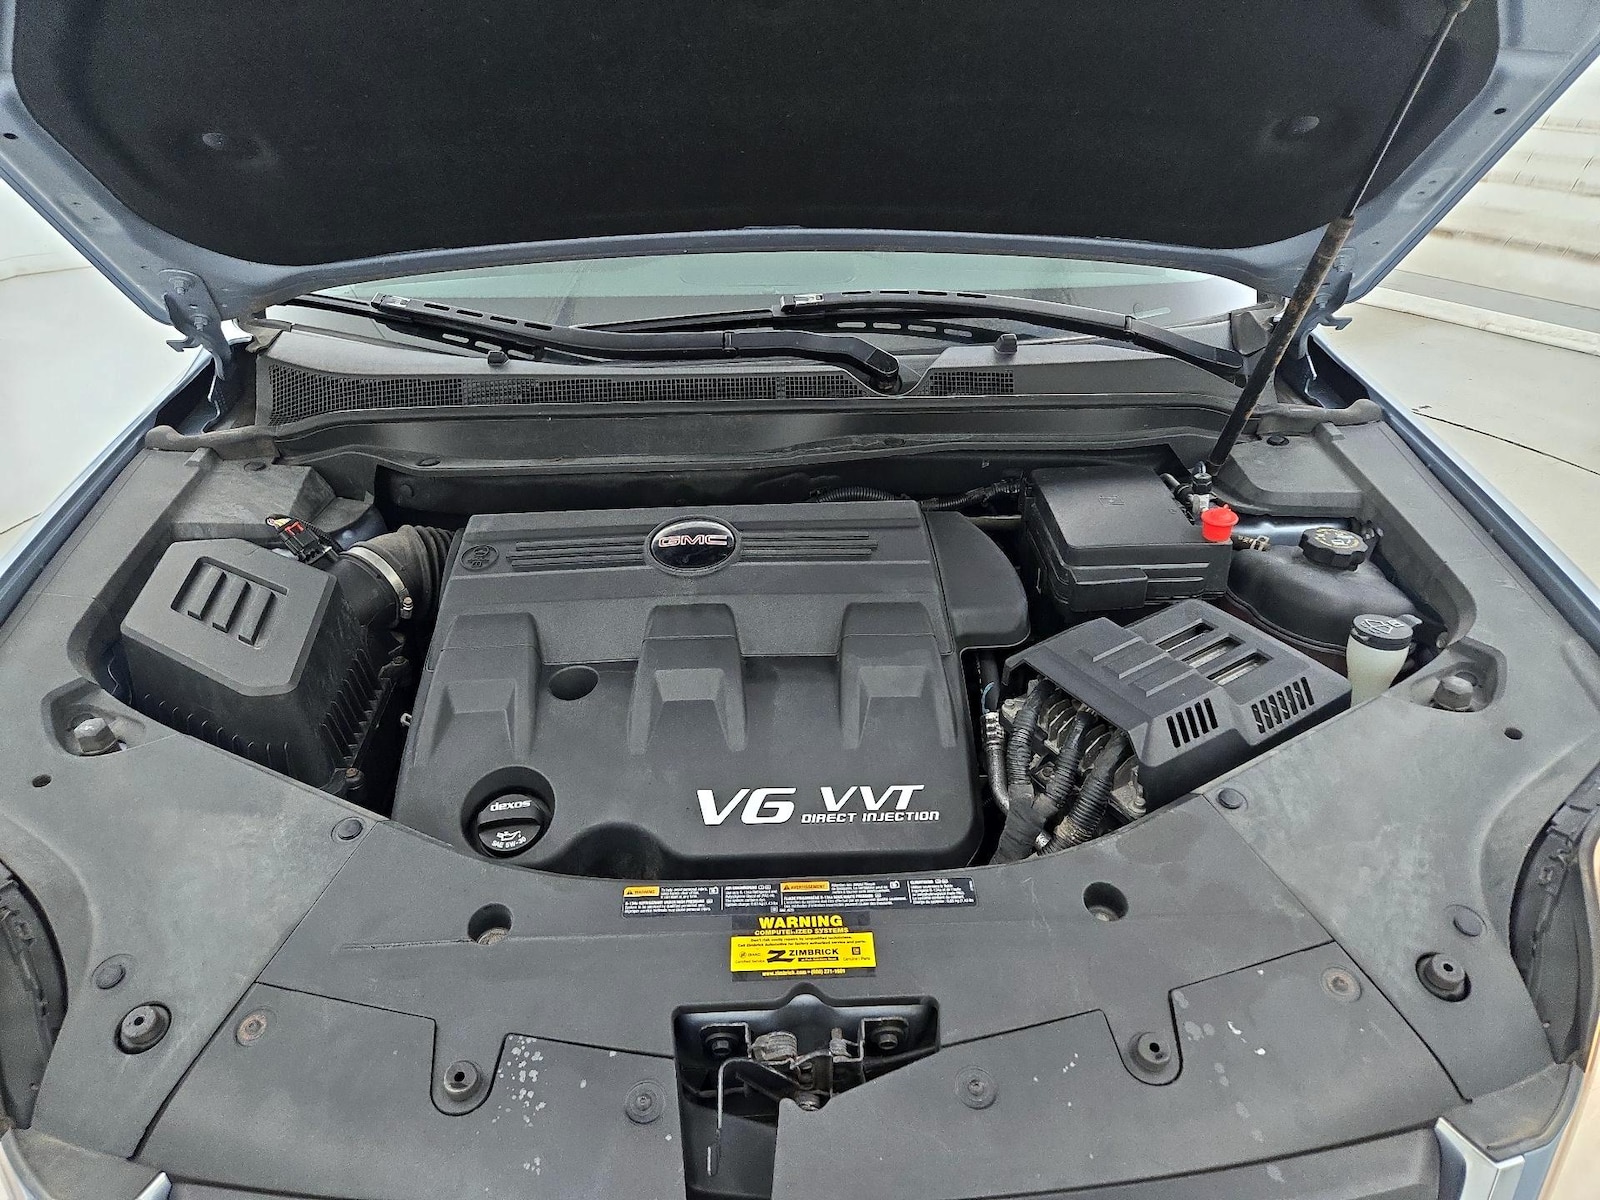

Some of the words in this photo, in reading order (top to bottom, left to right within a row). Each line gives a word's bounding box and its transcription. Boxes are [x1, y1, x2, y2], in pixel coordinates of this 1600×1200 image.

[659, 534, 728, 548] GMC
[820, 784, 925, 811] VVT
[490, 799, 532, 812] dexos
[697, 787, 797, 825] V6
[801, 812, 857, 824] DIRECT
[862, 810, 940, 822] INJECTION
[491, 839, 504, 849] SAE
[505, 836, 527, 849] 5W-30
[758, 914, 843, 929] WARNING
[789, 948, 839, 957] ZIMBRICK
